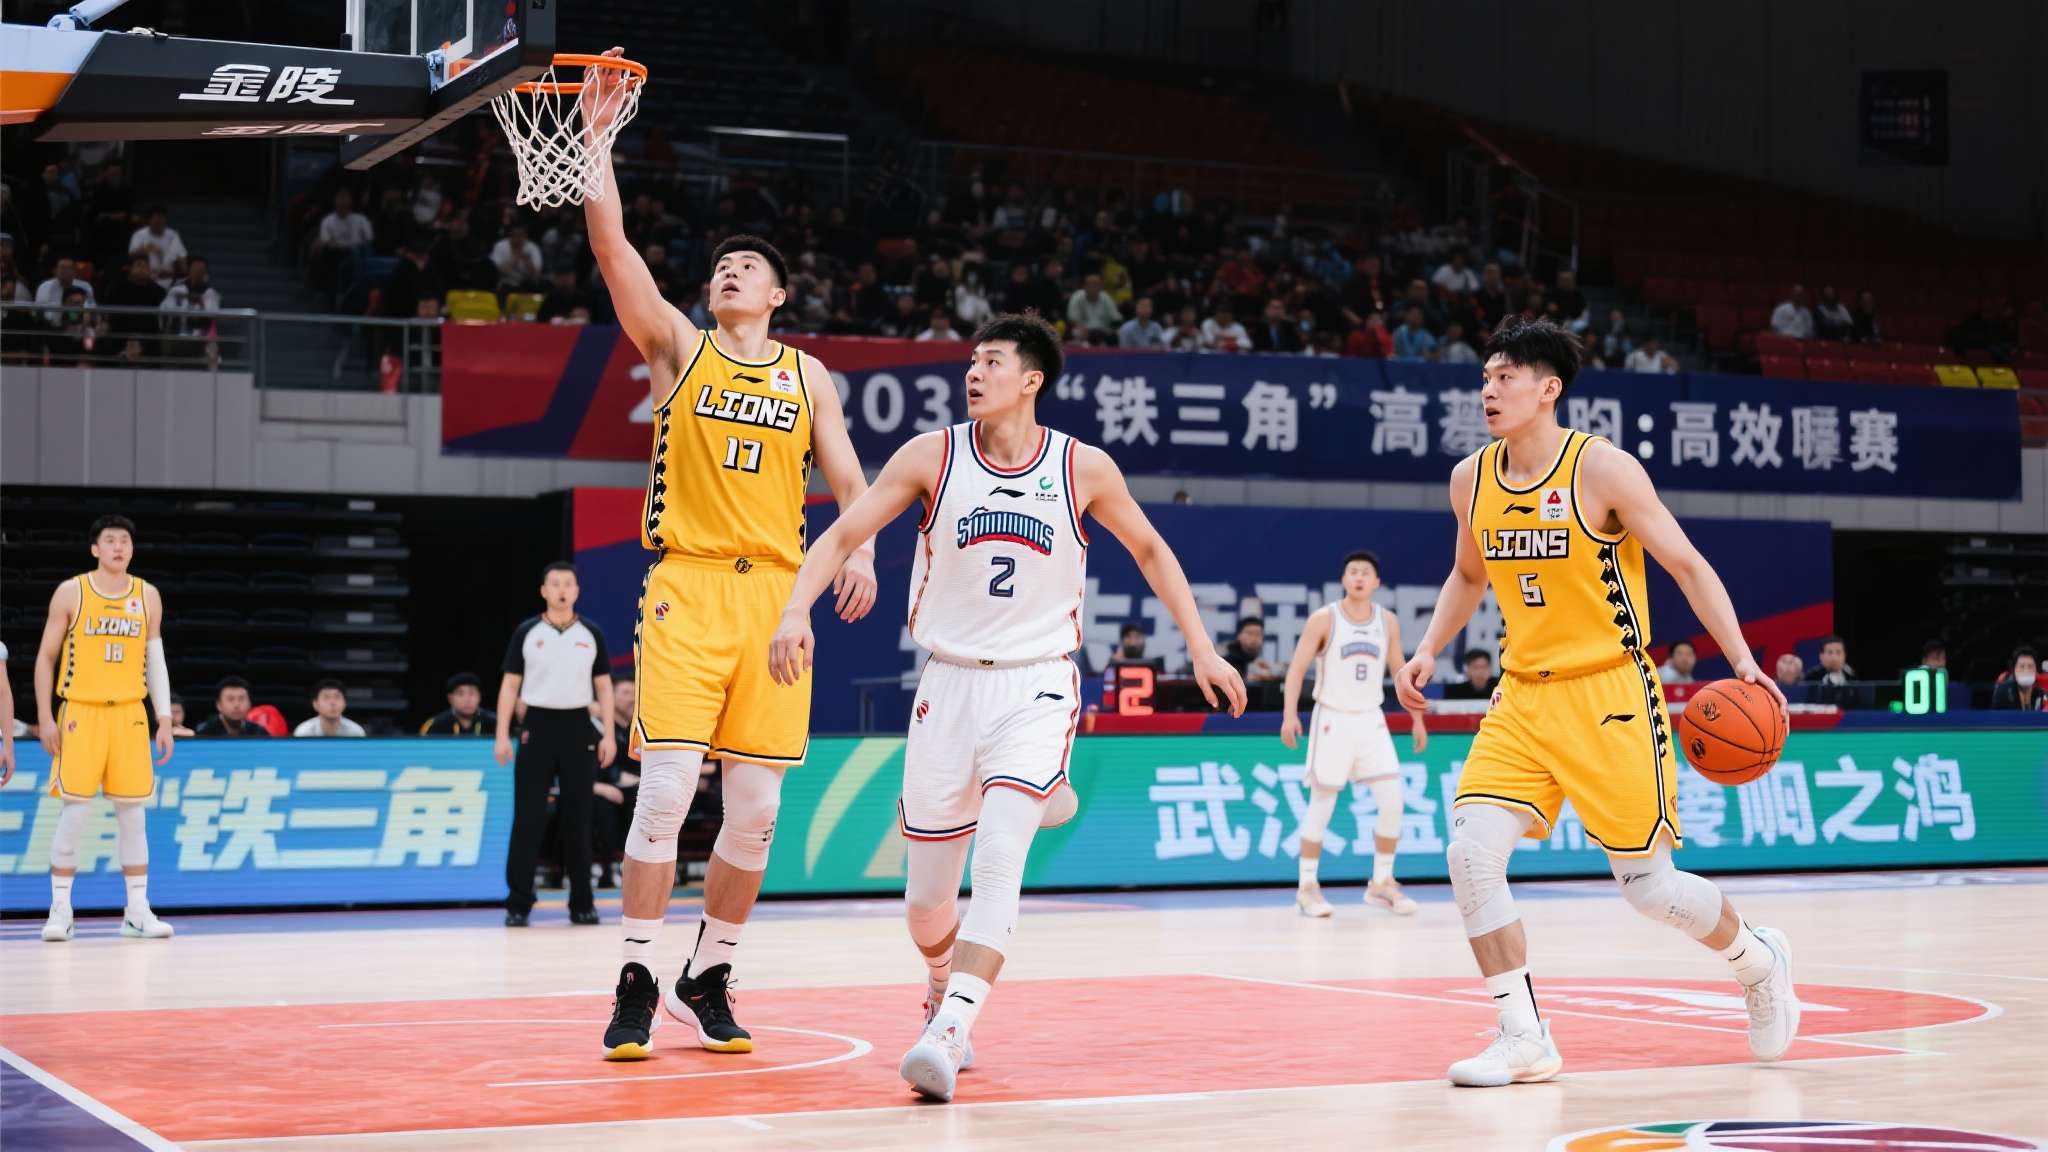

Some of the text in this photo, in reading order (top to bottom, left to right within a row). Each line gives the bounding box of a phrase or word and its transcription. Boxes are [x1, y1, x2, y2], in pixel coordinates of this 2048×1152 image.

[178, 63, 355, 106] 金陵
[694, 384, 801, 433] LIONS
[722, 435, 763, 474] 17
[1482, 528, 1570, 560] LIONS
[989, 556, 1015, 597] 2
[1517, 573, 1546, 607] 5
[84, 615, 141, 637] LIONS
[1118, 666, 1154, 716] 2
